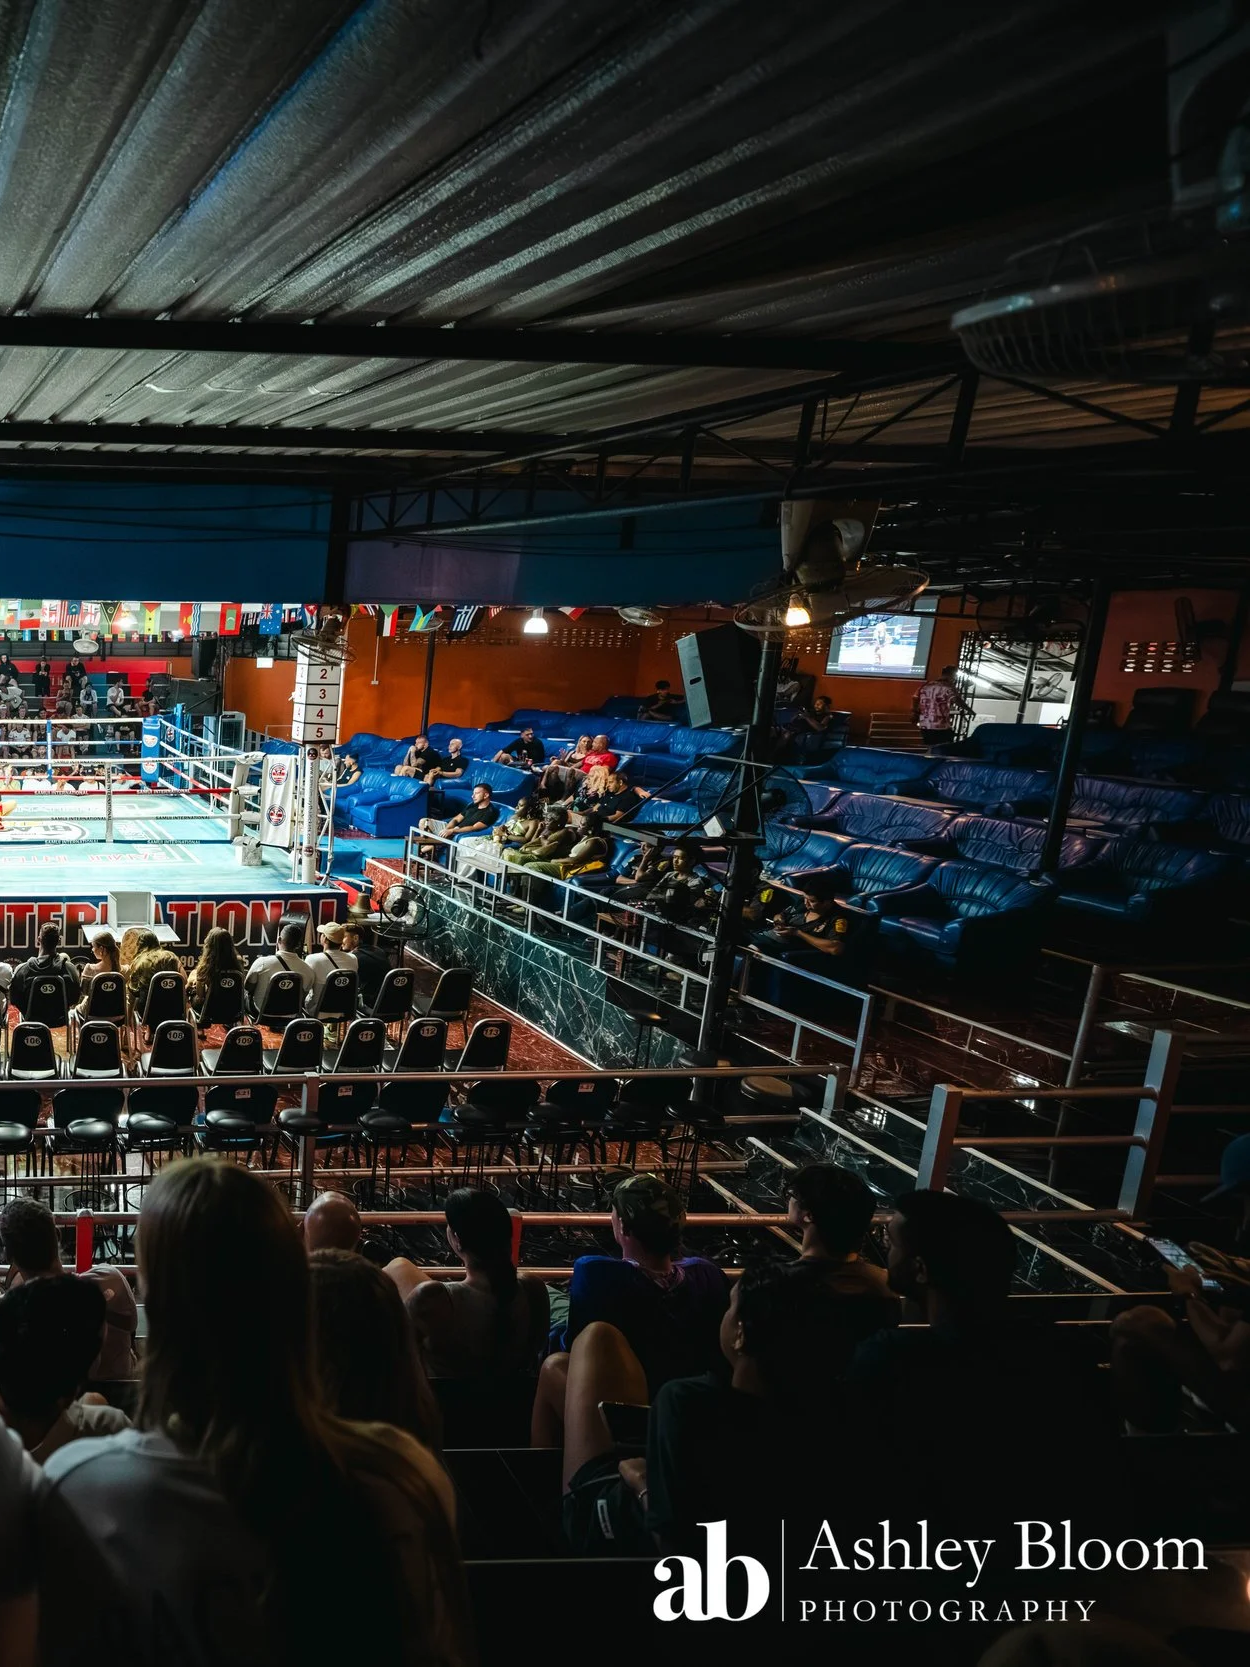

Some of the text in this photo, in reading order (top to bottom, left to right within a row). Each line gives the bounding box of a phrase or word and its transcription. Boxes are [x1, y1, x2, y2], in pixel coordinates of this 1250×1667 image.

[320, 668, 327, 679] 2
[319, 689, 326, 699] 3
[317, 708, 324, 719] 4
[316, 728, 323, 738] 5
[162, 980, 174, 988] 95
[222, 979, 234, 987] 96
[280, 980, 292, 989] 97
[336, 978, 347, 986] 98
[395, 978, 406, 986] 99
[42, 985, 54, 993] 93
[102, 983, 115, 991] 94
[421, 1027, 436, 1036] 112
[483, 1028, 499, 1036] 113
[91, 1034, 107, 1042] 107
[168, 1032, 183, 1040] 108
[297, 1032, 312, 1040] 110
[359, 1032, 374, 1040] 111
[25, 1037, 41, 1045] 106
[236, 1036, 252, 1045] 109
